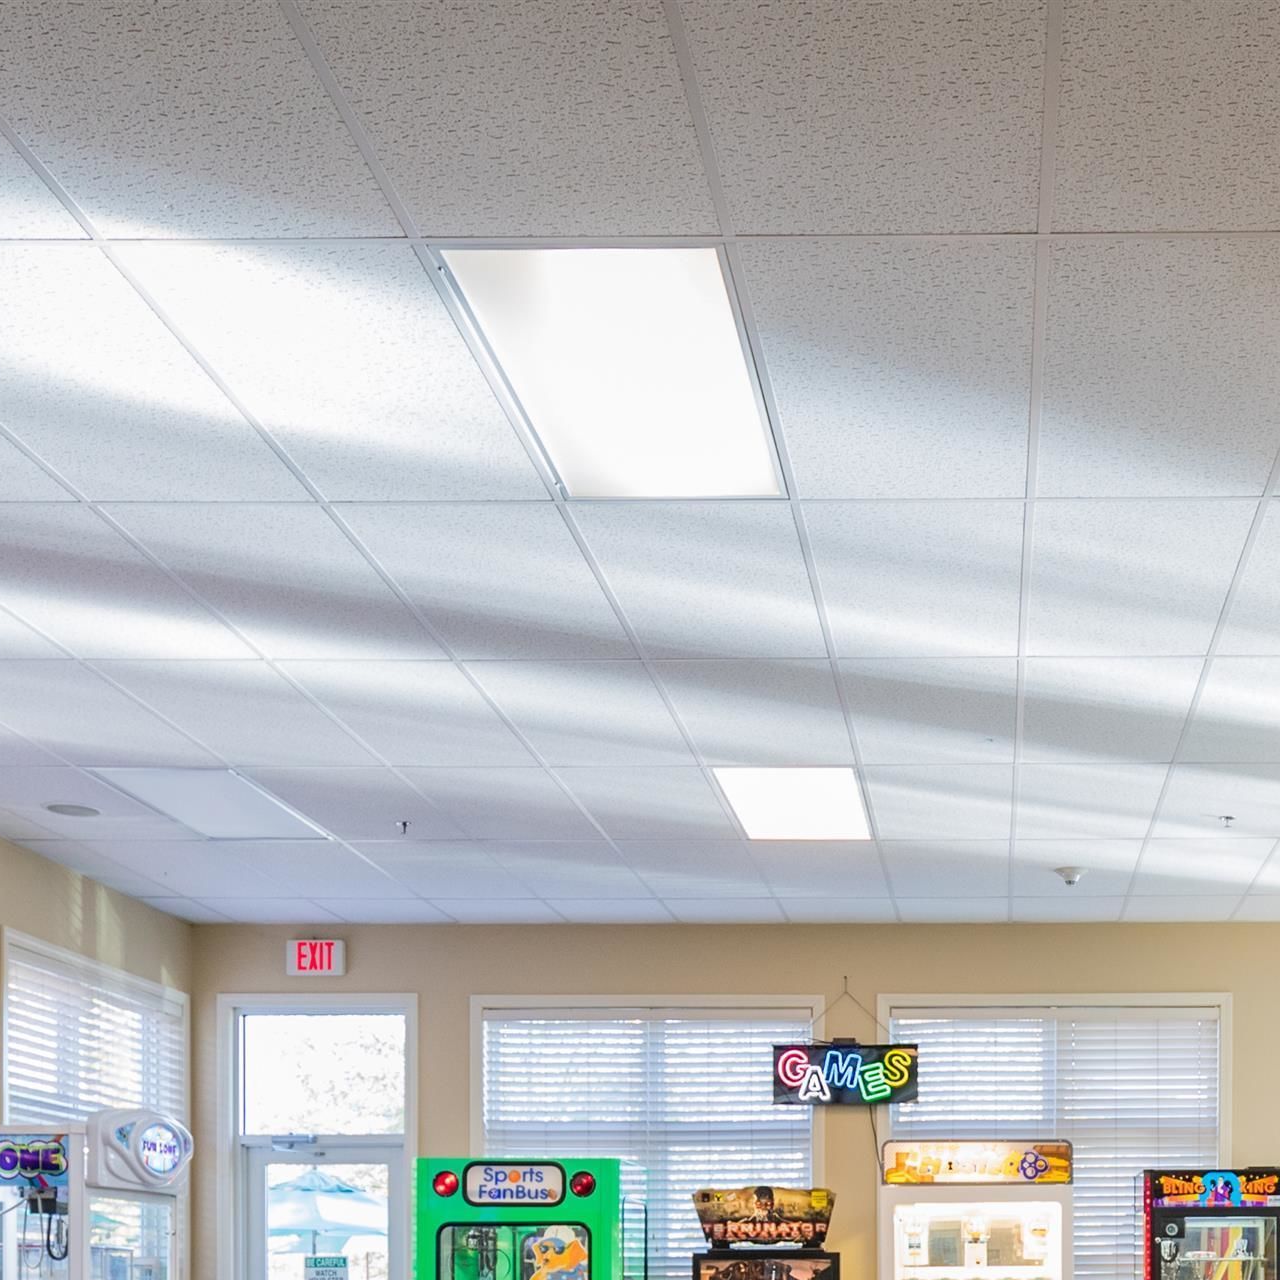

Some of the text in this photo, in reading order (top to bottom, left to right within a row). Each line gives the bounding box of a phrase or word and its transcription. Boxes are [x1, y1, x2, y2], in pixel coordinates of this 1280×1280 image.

[297, 942, 335, 971] EXIT
[777, 1049, 912, 1102] GAMES
[483, 1167, 544, 1184] Sports
[478, 1185, 549, 1200] FanBus
[1163, 1181, 1276, 1195] BLING KING
[703, 1220, 827, 1233] TERMINATOR
[713, 1230, 814, 1240] SALVATION
